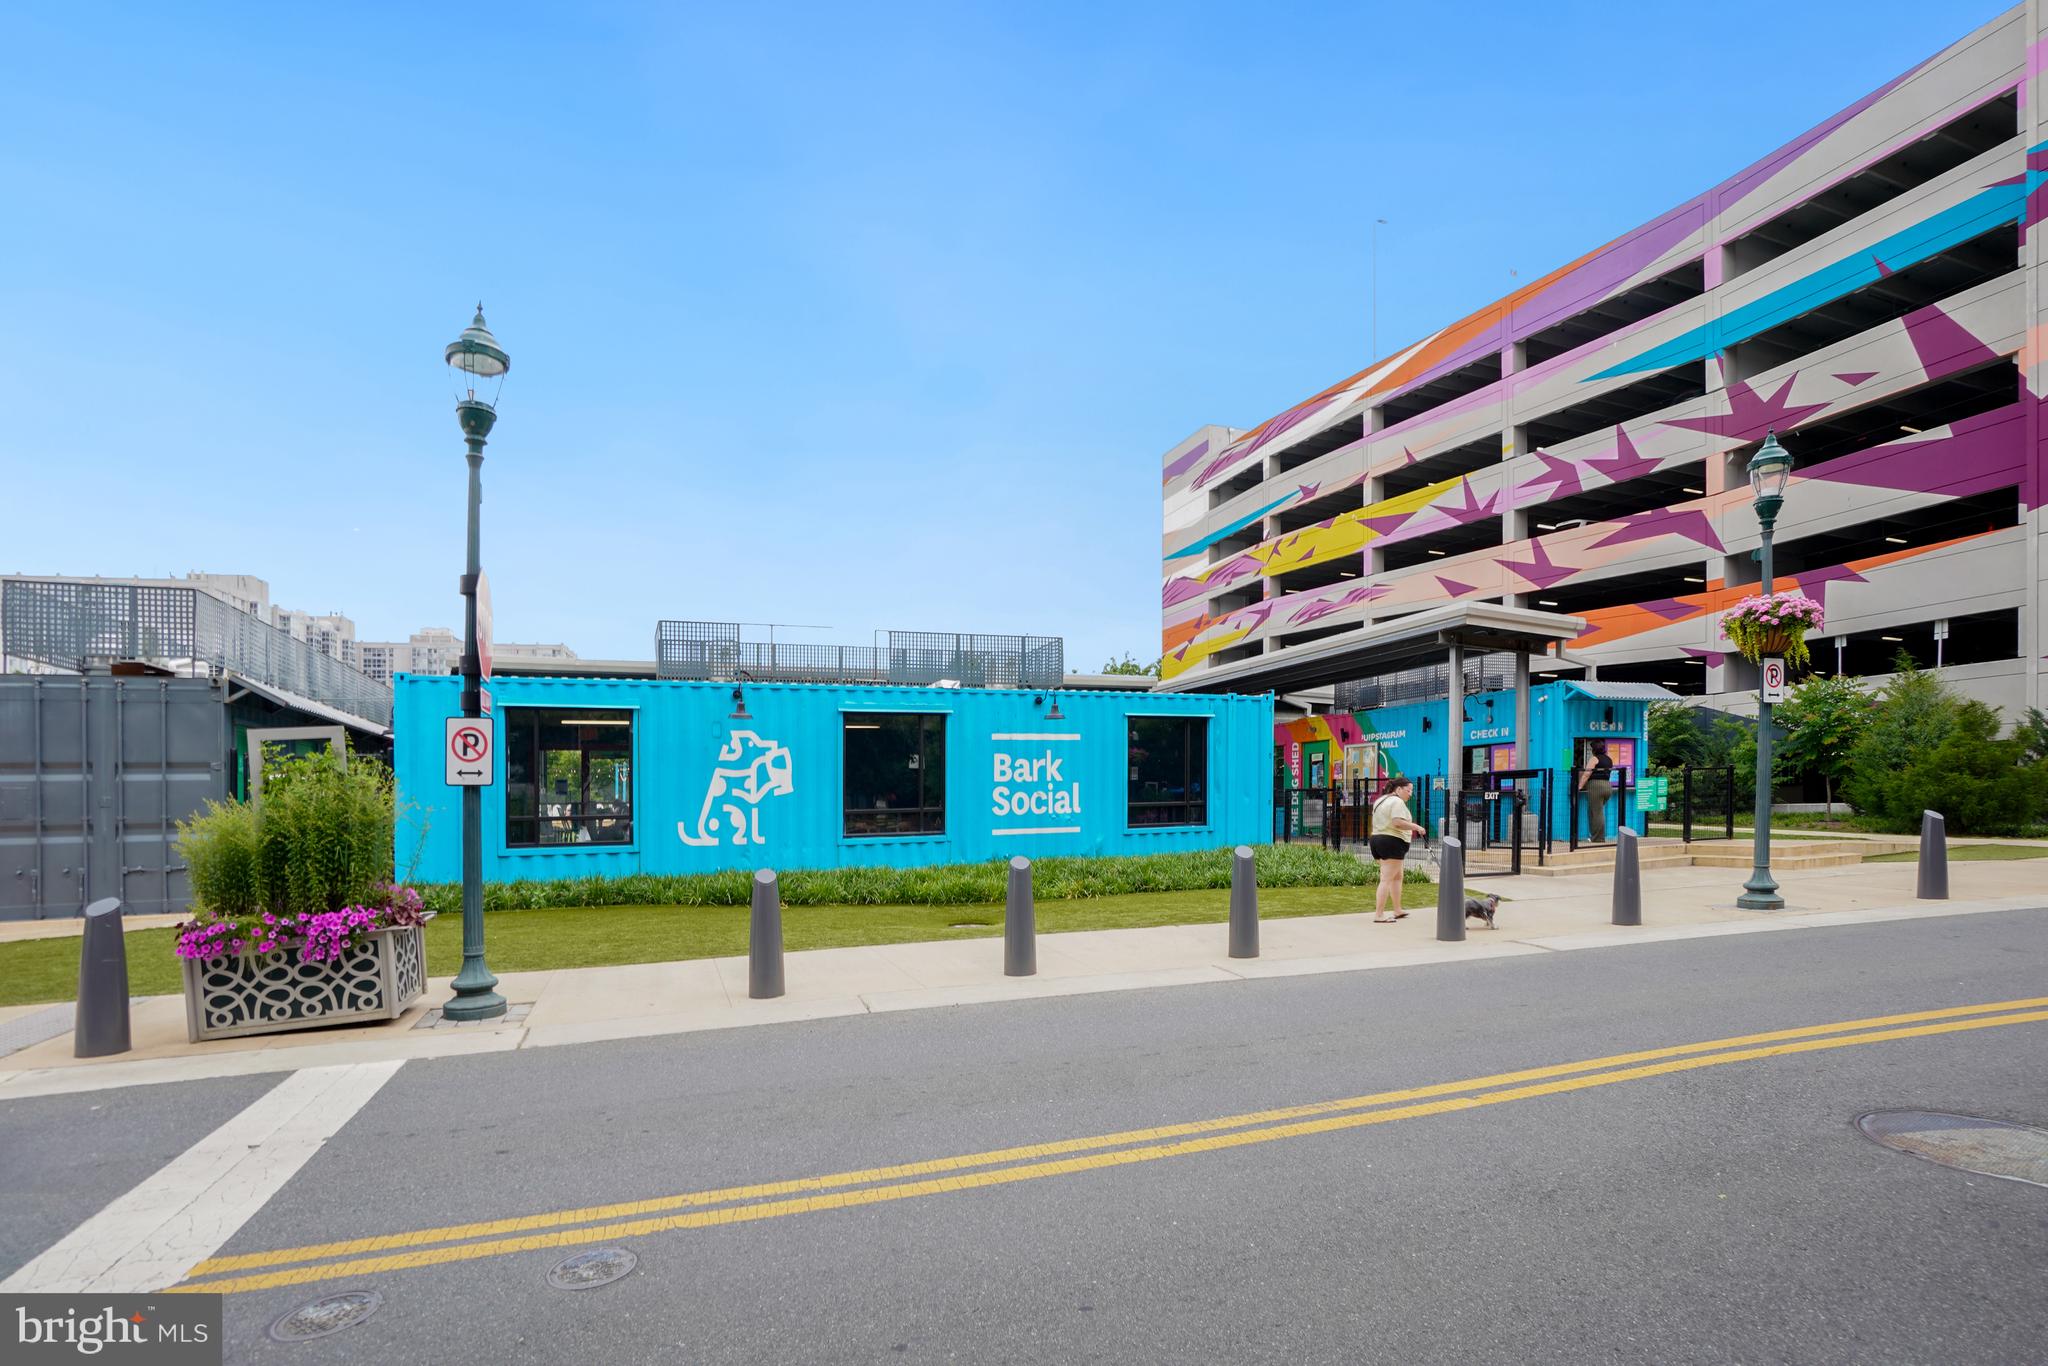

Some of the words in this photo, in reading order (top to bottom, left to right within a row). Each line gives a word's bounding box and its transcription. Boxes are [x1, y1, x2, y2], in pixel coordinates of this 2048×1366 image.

[1470, 728, 1499, 740] CHECK
[1501, 727, 1509, 737] IN
[993, 749, 1064, 782] Bark
[1291, 742, 1299, 777] SHED
[992, 782, 1081, 816] Social
[1484, 792, 1499, 800] EXIT
[1291, 807, 1299, 833] THE
